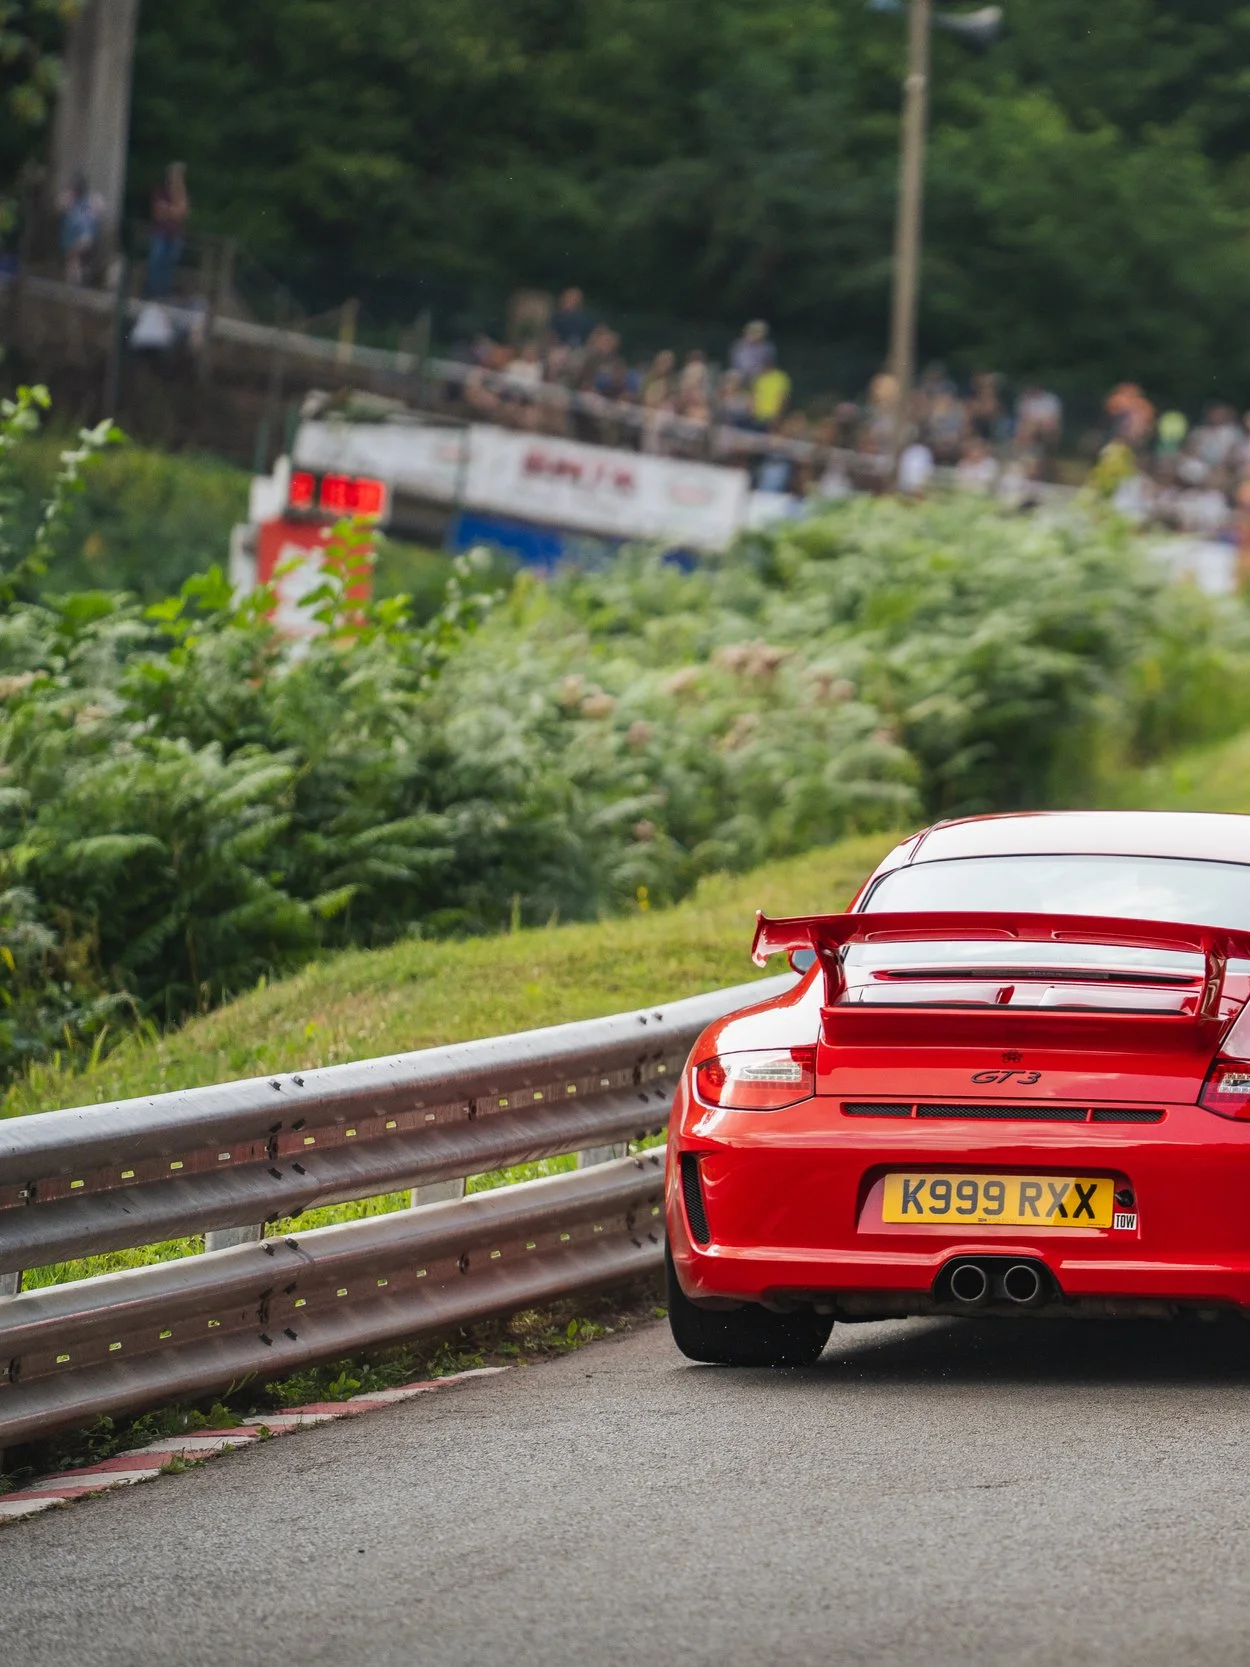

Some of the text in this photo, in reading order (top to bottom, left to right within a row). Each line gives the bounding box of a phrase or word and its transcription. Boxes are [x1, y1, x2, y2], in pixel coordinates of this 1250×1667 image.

[971, 1070, 1041, 1085] GT3
[901, 1179, 1098, 1219] K999 RXX
[1116, 1214, 1135, 1229] TOW
